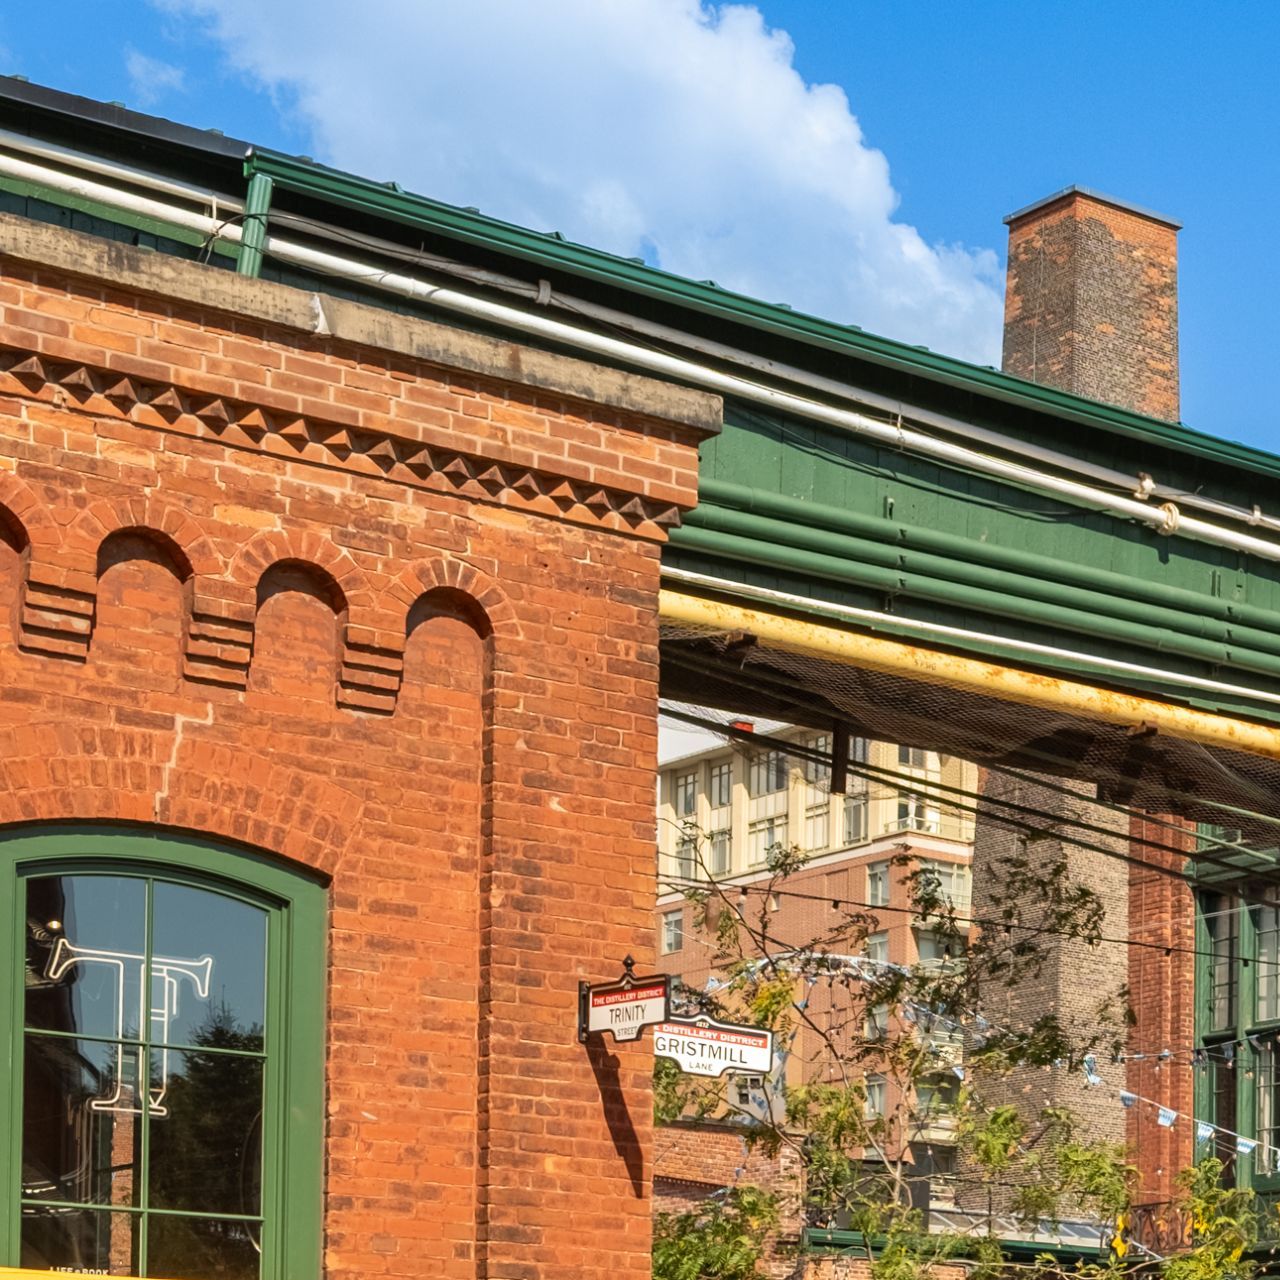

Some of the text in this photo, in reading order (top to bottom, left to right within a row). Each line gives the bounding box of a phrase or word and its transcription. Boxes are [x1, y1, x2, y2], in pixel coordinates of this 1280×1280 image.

[594, 987, 664, 1006] THE DISTILLERY DISTRICT
[609, 1004, 647, 1024] TRINITY
[617, 1026, 638, 1037] STREET
[663, 1025, 718, 1039] DISTILLERY
[720, 1034, 764, 1046] DISTRICT
[655, 1037, 748, 1064] GRISTMILL
[689, 1062, 713, 1072] LANE
